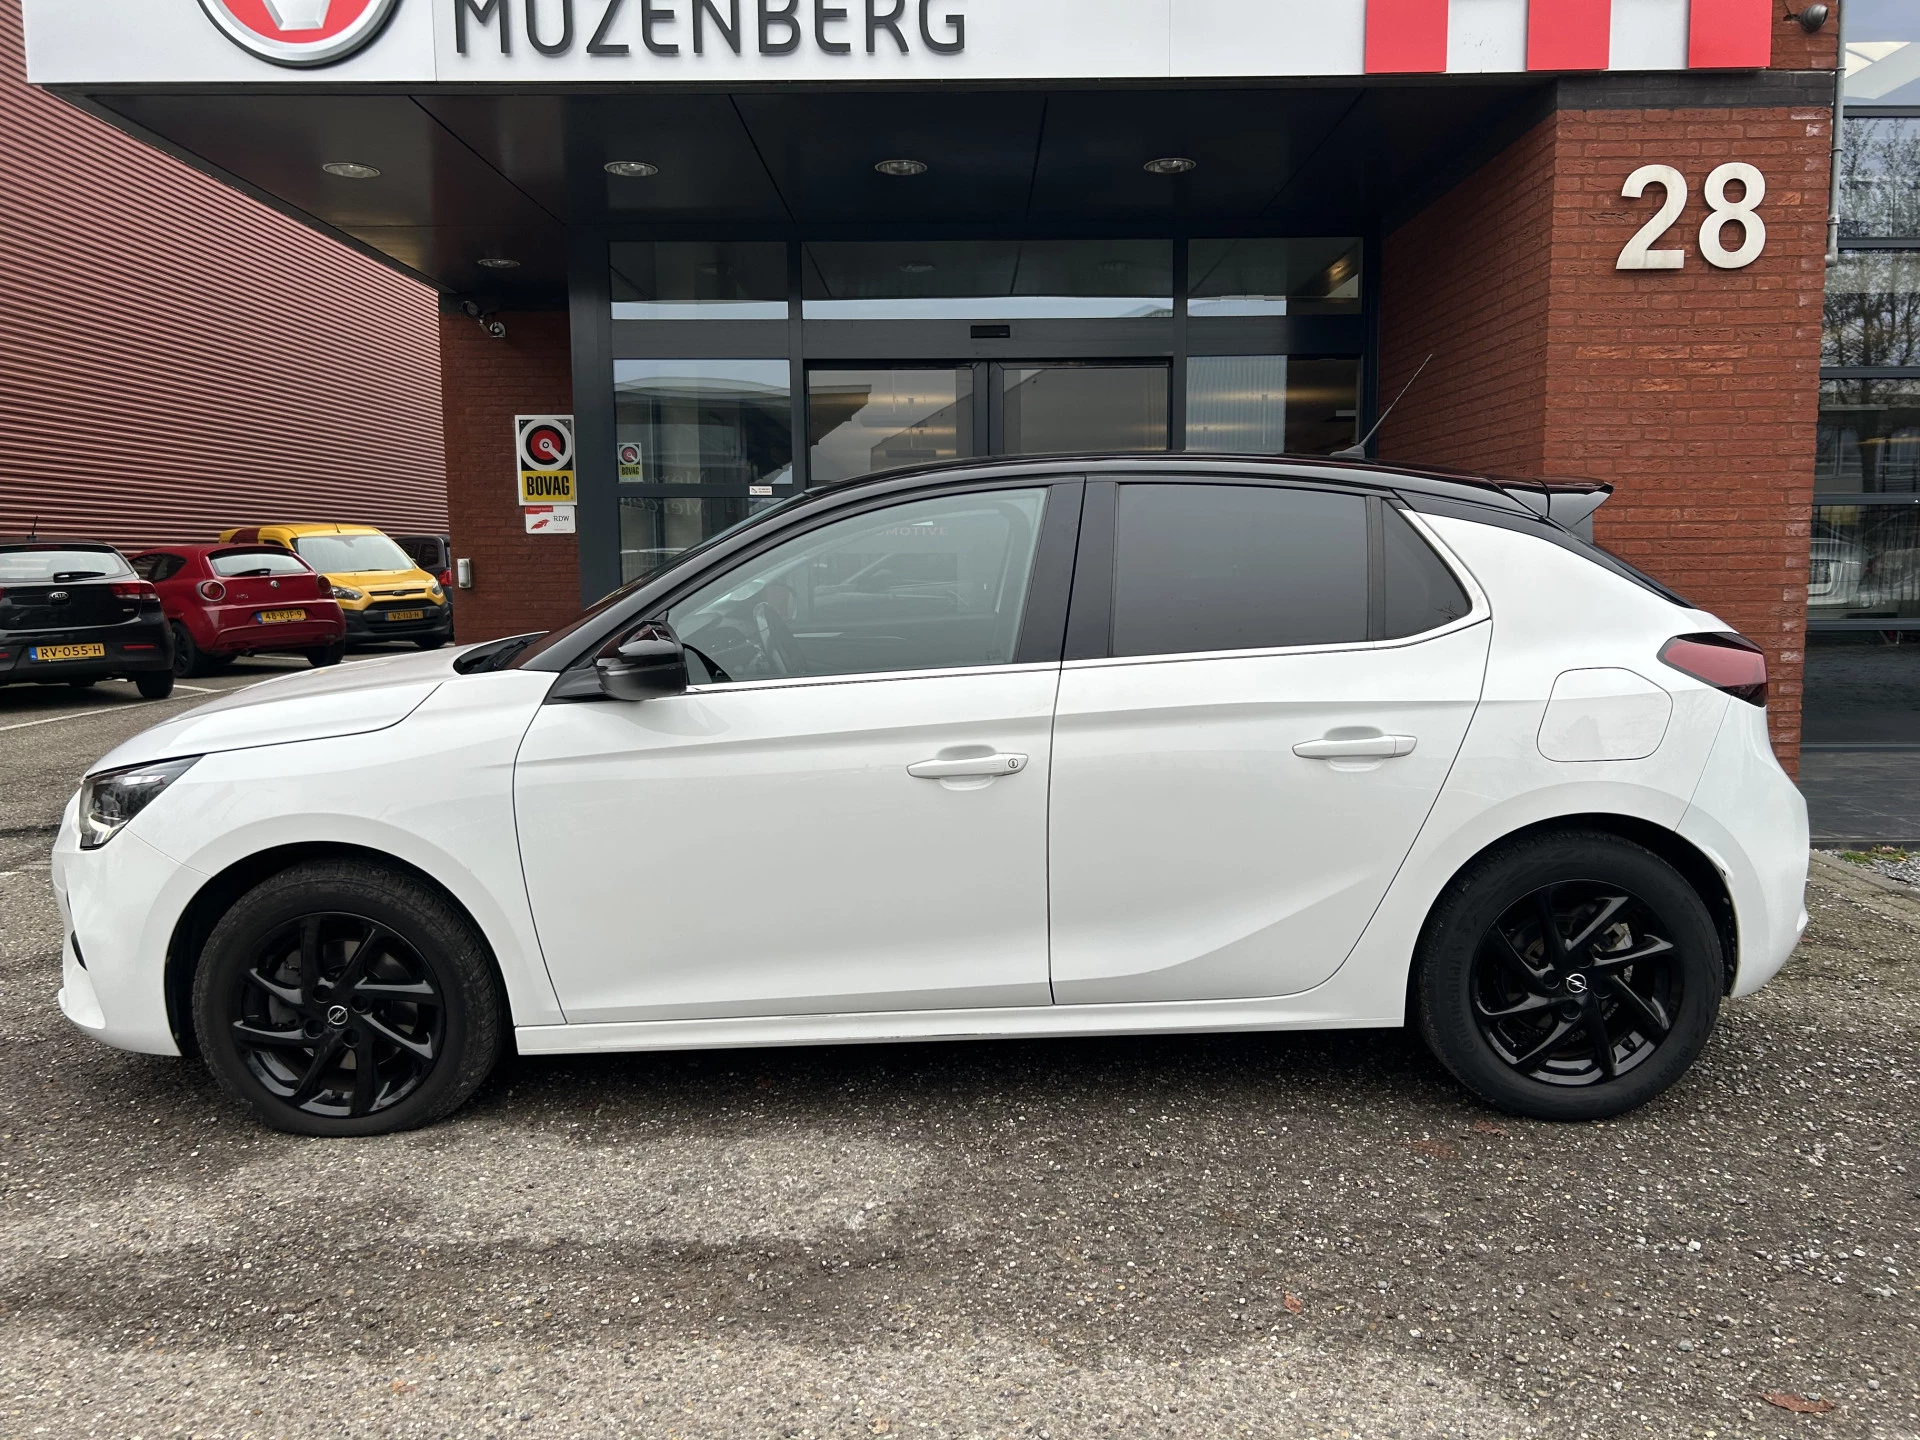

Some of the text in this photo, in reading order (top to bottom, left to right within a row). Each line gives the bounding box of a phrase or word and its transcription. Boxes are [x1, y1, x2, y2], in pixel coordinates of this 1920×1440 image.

[456, 0, 965, 55] MUZENBERG
[1616, 162, 1766, 269] 28
[621, 466, 640, 476] BOVAG
[526, 475, 570, 496] BOVAG
[265, 610, 302, 620] 48-RJF-9
[41, 645, 101, 658] RV-055-H
